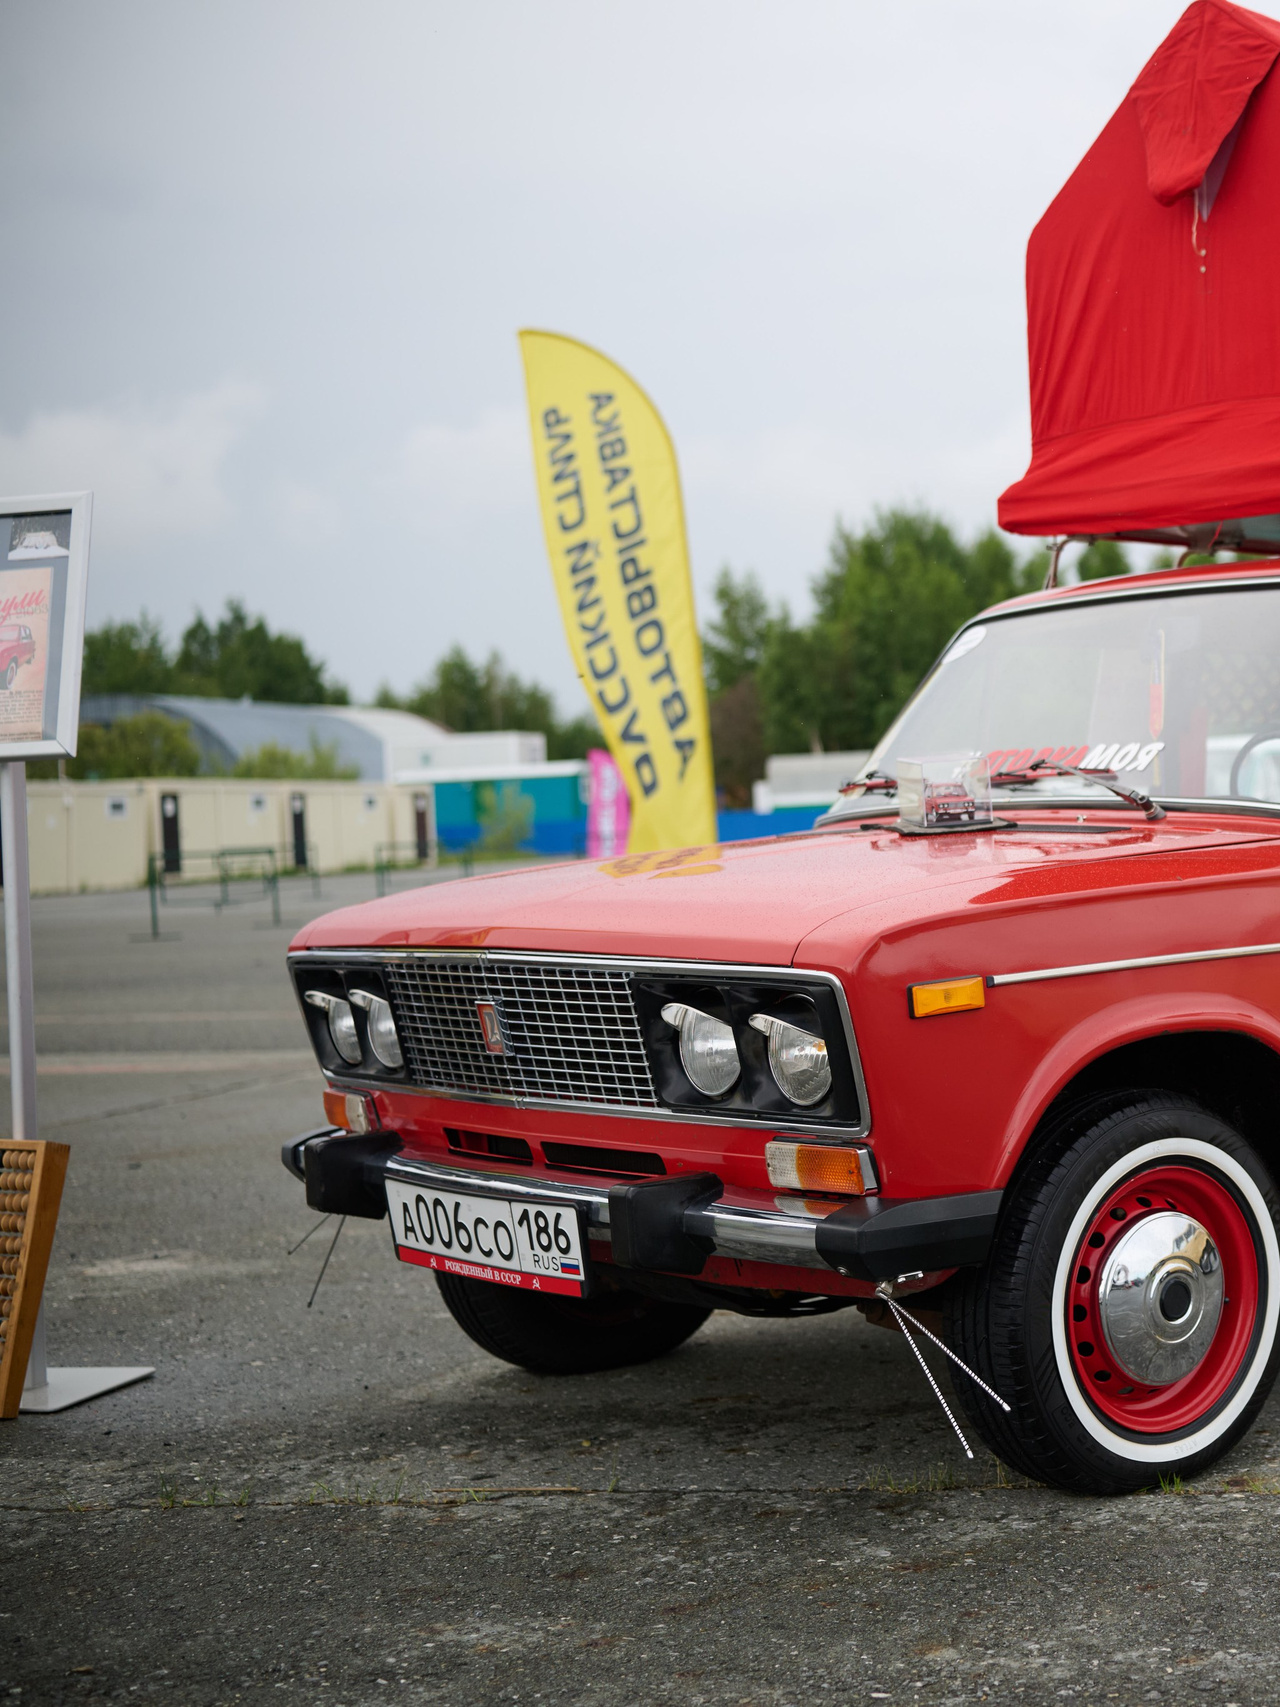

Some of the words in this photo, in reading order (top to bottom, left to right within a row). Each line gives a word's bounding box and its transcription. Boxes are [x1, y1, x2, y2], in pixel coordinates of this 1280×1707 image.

[517, 1208, 571, 1255] 186
[444, 1259, 494, 1281] РОЖДЕННЫЙ
[494, 1270, 501, 1281] В
[500, 1272, 522, 1285] СССР
[533, 1254, 560, 1272] RUS
